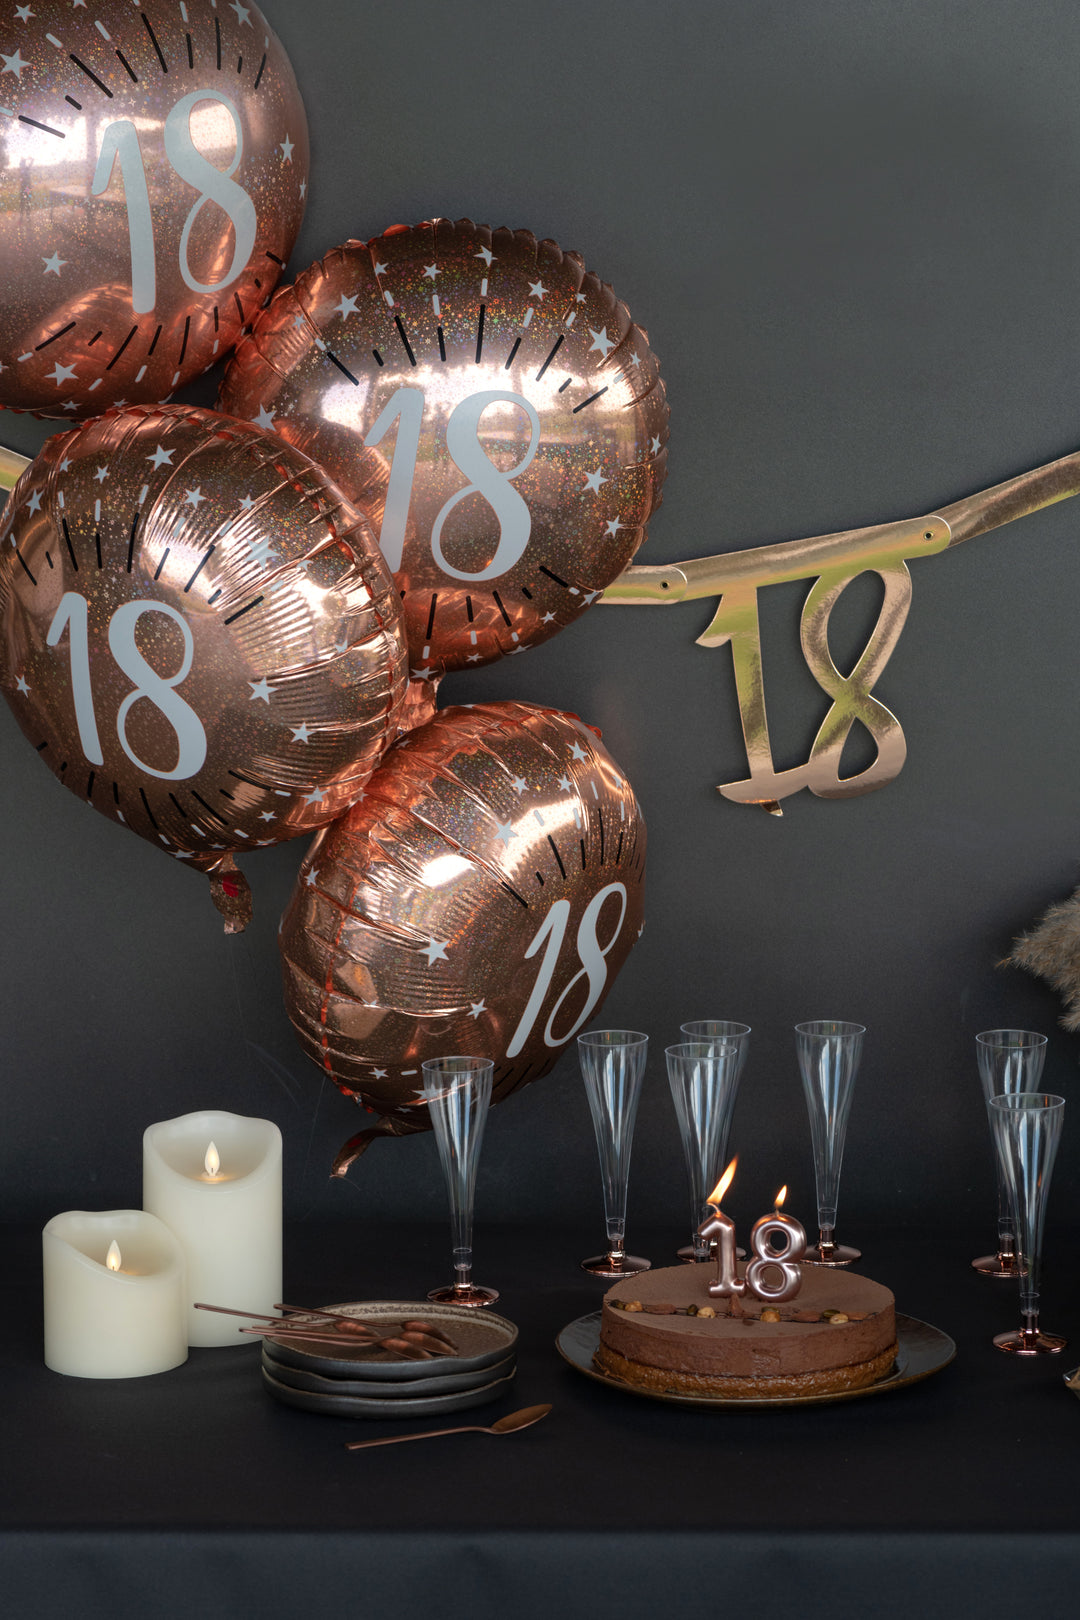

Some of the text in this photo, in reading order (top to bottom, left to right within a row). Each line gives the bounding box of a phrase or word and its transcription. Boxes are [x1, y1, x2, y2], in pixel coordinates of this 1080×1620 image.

[91, 88, 257, 314] 18
[363, 387, 542, 582] 18
[46, 591, 208, 781] 18
[695, 558, 913, 804] 18
[505, 882, 628, 1058] 18
[698, 1209, 808, 1302] 18
